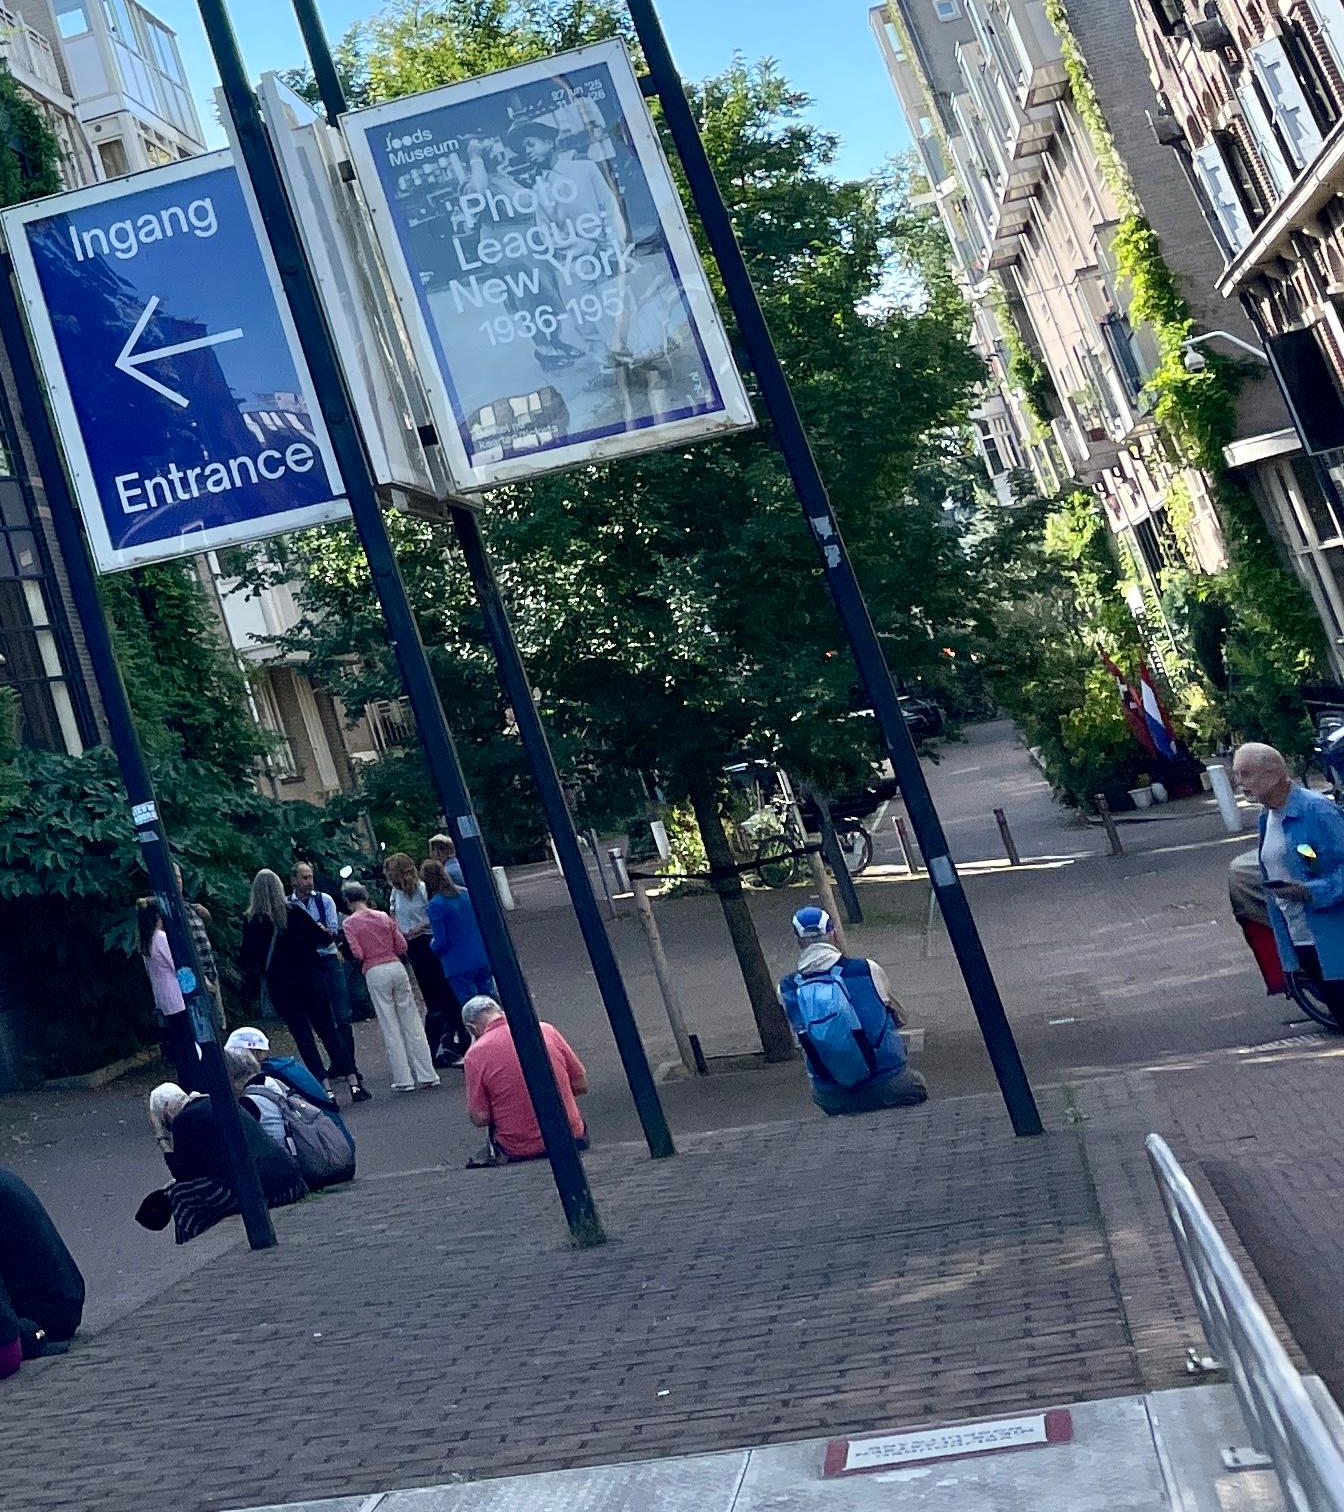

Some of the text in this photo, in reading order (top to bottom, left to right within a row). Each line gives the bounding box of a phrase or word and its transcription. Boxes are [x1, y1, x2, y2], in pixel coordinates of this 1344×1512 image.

[385, 129, 433, 152] Joods
[388, 139, 460, 167] Museum
[69, 197, 218, 262] Ingang
[459, 175, 578, 228] Photo
[453, 211, 612, 271] League:
[448, 239, 639, 313] New York
[115, 442, 315, 515] Entrance
